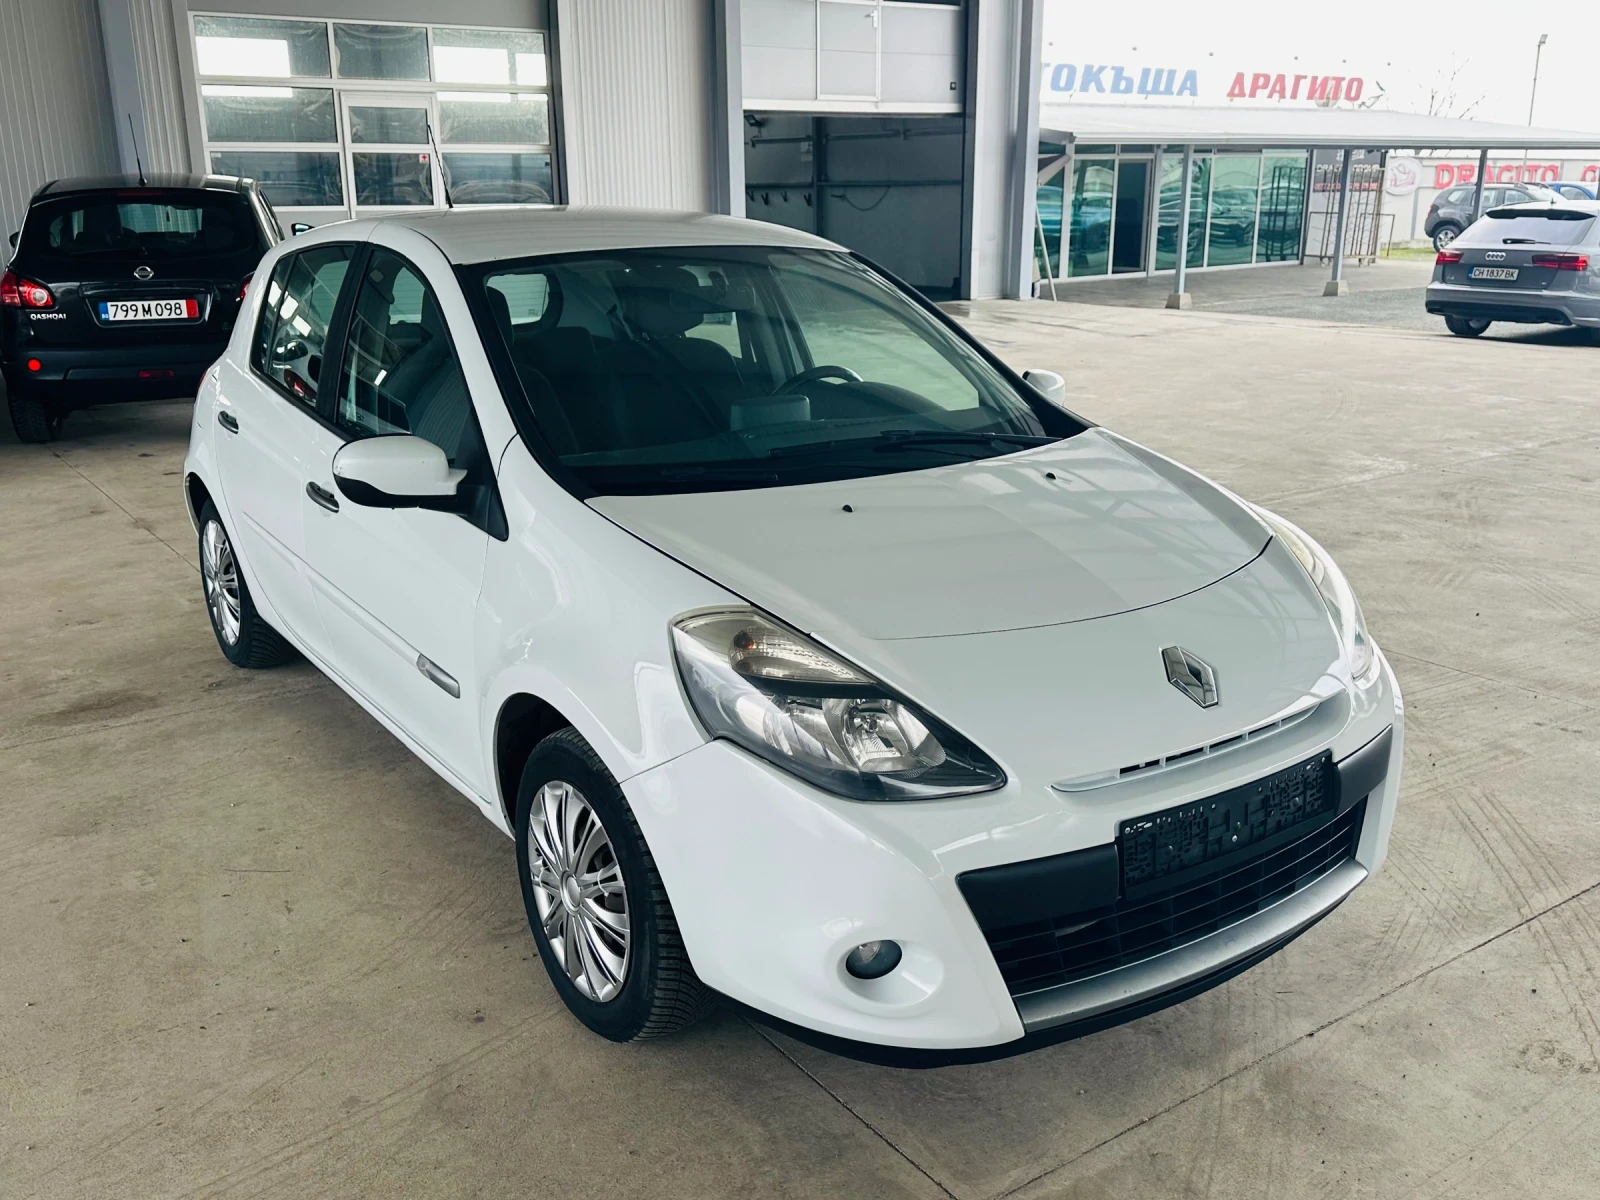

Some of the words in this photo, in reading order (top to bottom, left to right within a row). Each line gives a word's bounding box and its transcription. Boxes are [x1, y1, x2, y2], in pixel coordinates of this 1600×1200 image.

[1226, 71, 1364, 102] ДРАГИТО
[1473, 268, 1485, 277] CH
[1486, 269, 1505, 278] 1837
[1505, 269, 1516, 279] BK
[110, 303, 139, 318] 799
[141, 303, 152, 317] M
[154, 302, 183, 316] 098
